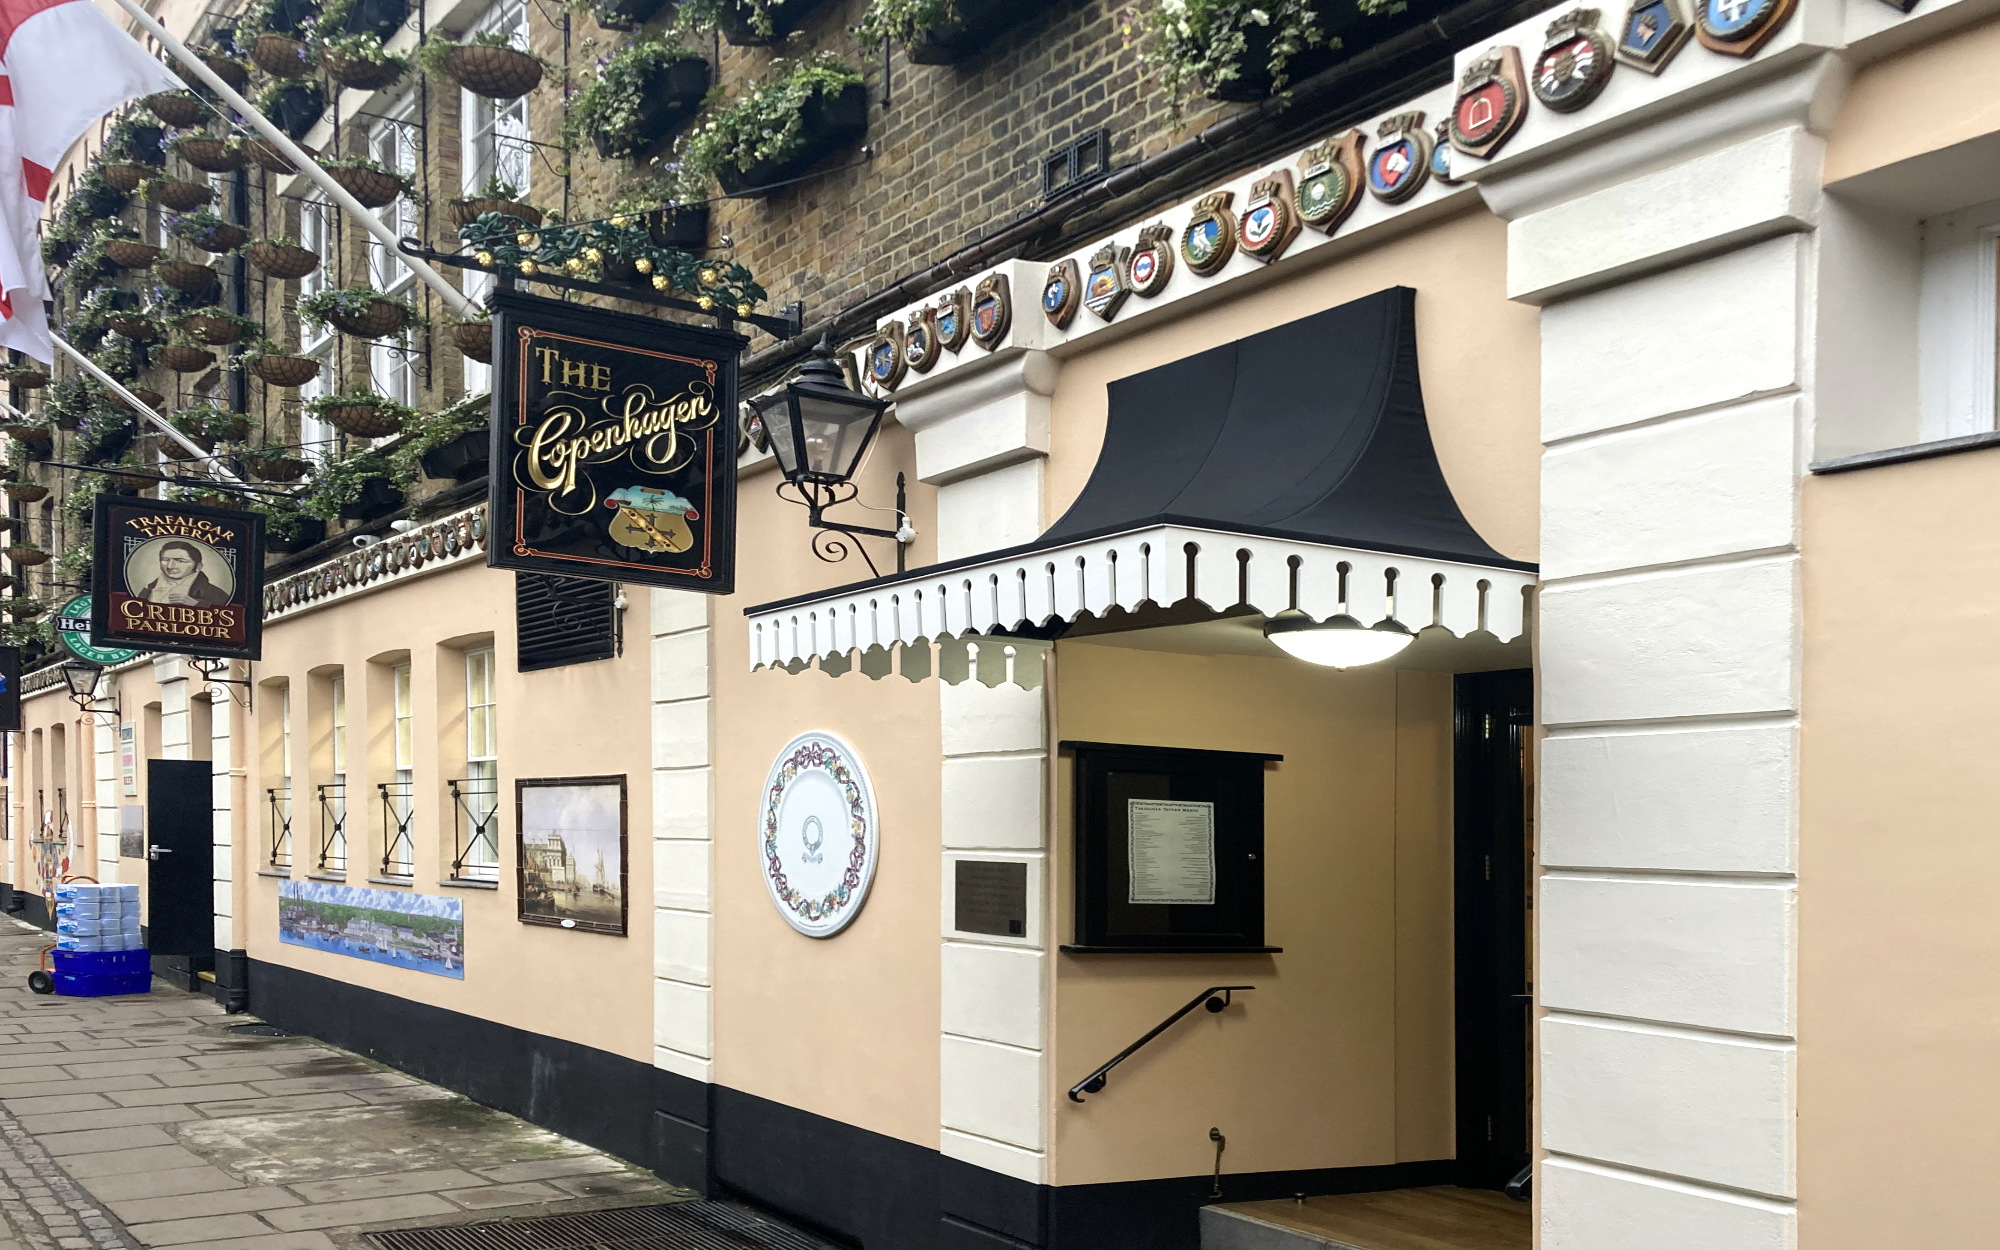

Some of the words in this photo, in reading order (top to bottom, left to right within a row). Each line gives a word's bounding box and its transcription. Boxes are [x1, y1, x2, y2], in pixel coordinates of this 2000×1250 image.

[534, 346, 611, 392] THE
[522, 387, 714, 503] Copenhagen
[125, 515, 235, 542] TRAFALGAR
[141, 525, 220, 545] TAVERN
[60, 618, 91, 631] Hei
[120, 600, 235, 627] CRIBB'S
[125, 617, 231, 639] PARLOUR
[69, 637, 105, 660] LAGER
